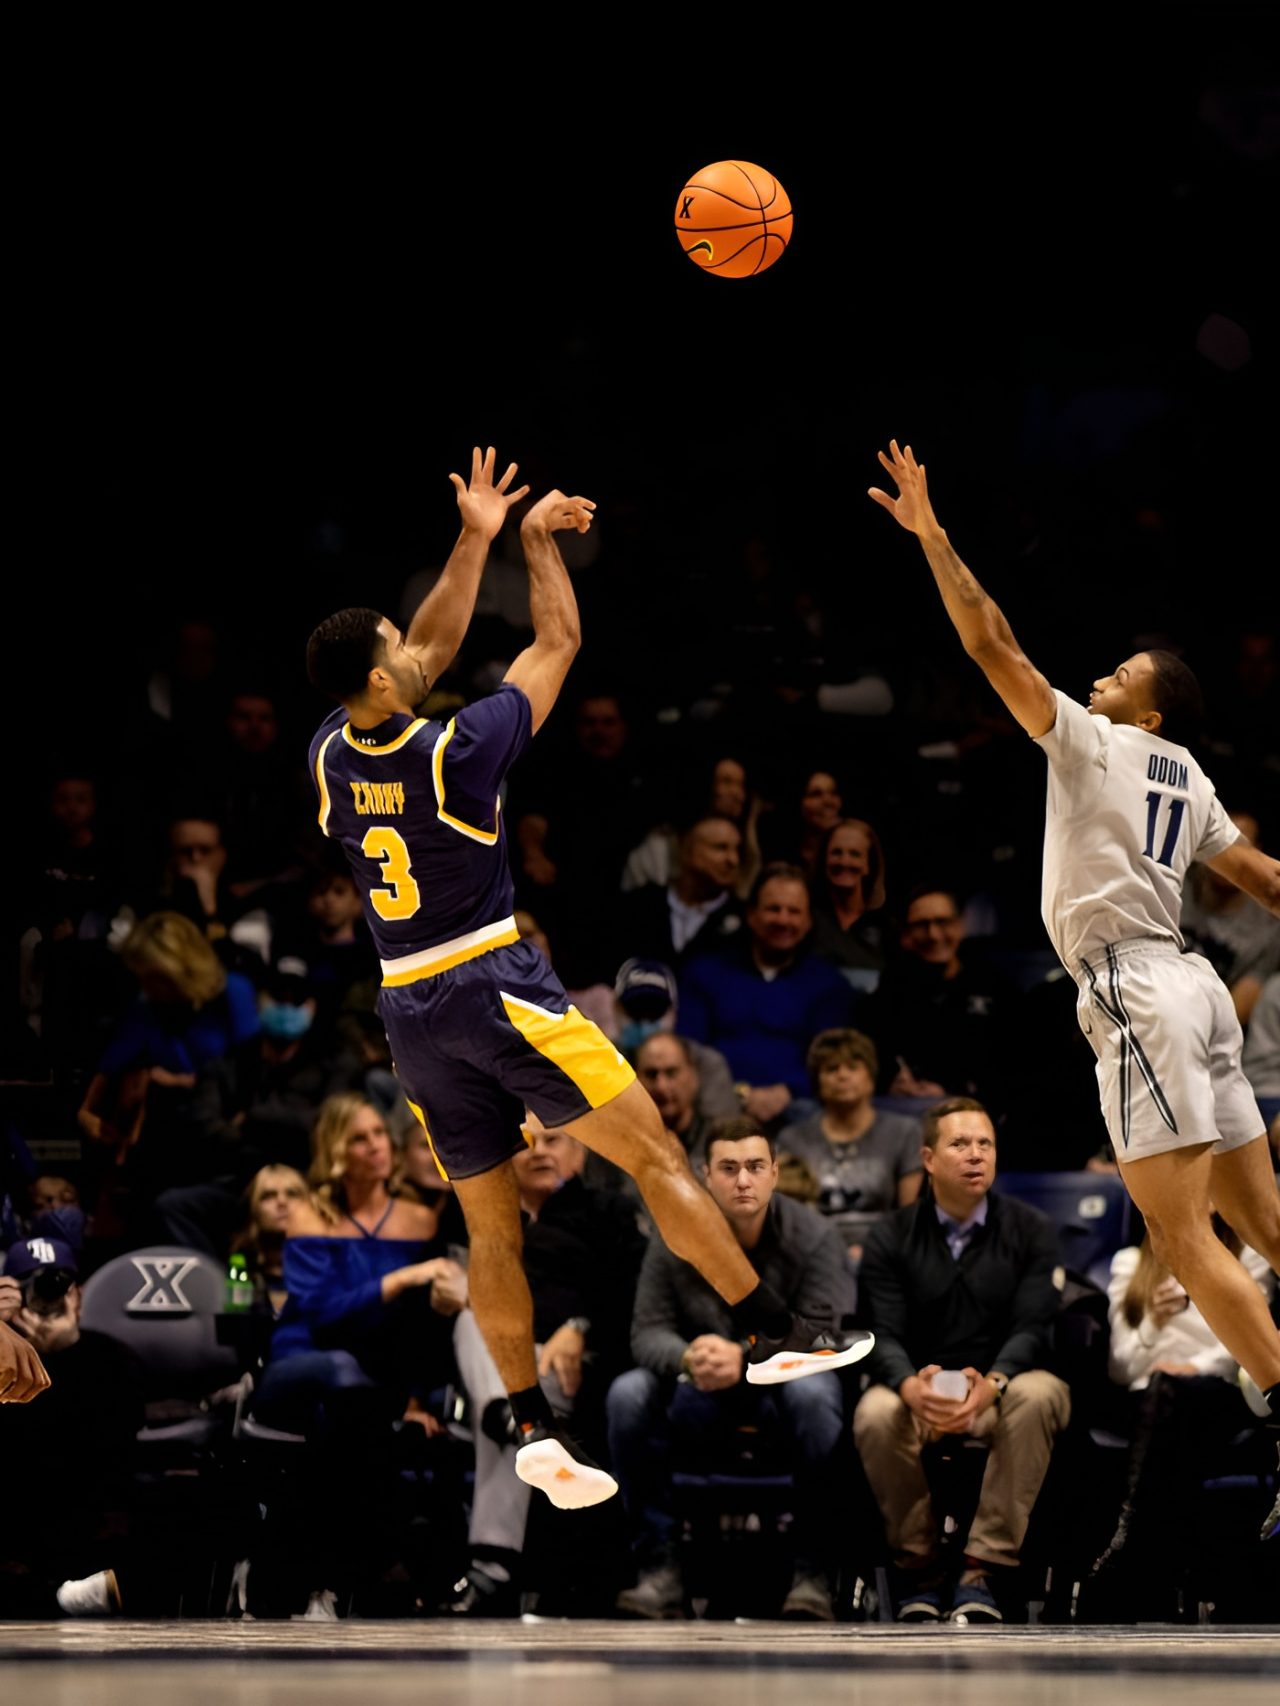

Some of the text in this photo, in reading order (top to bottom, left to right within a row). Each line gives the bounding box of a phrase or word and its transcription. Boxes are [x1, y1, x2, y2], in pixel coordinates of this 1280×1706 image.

[679, 195, 696, 219] X
[1147, 753, 1189, 792] ODOM
[1142, 790, 1185, 868] 11
[361, 826, 421, 921] 3
